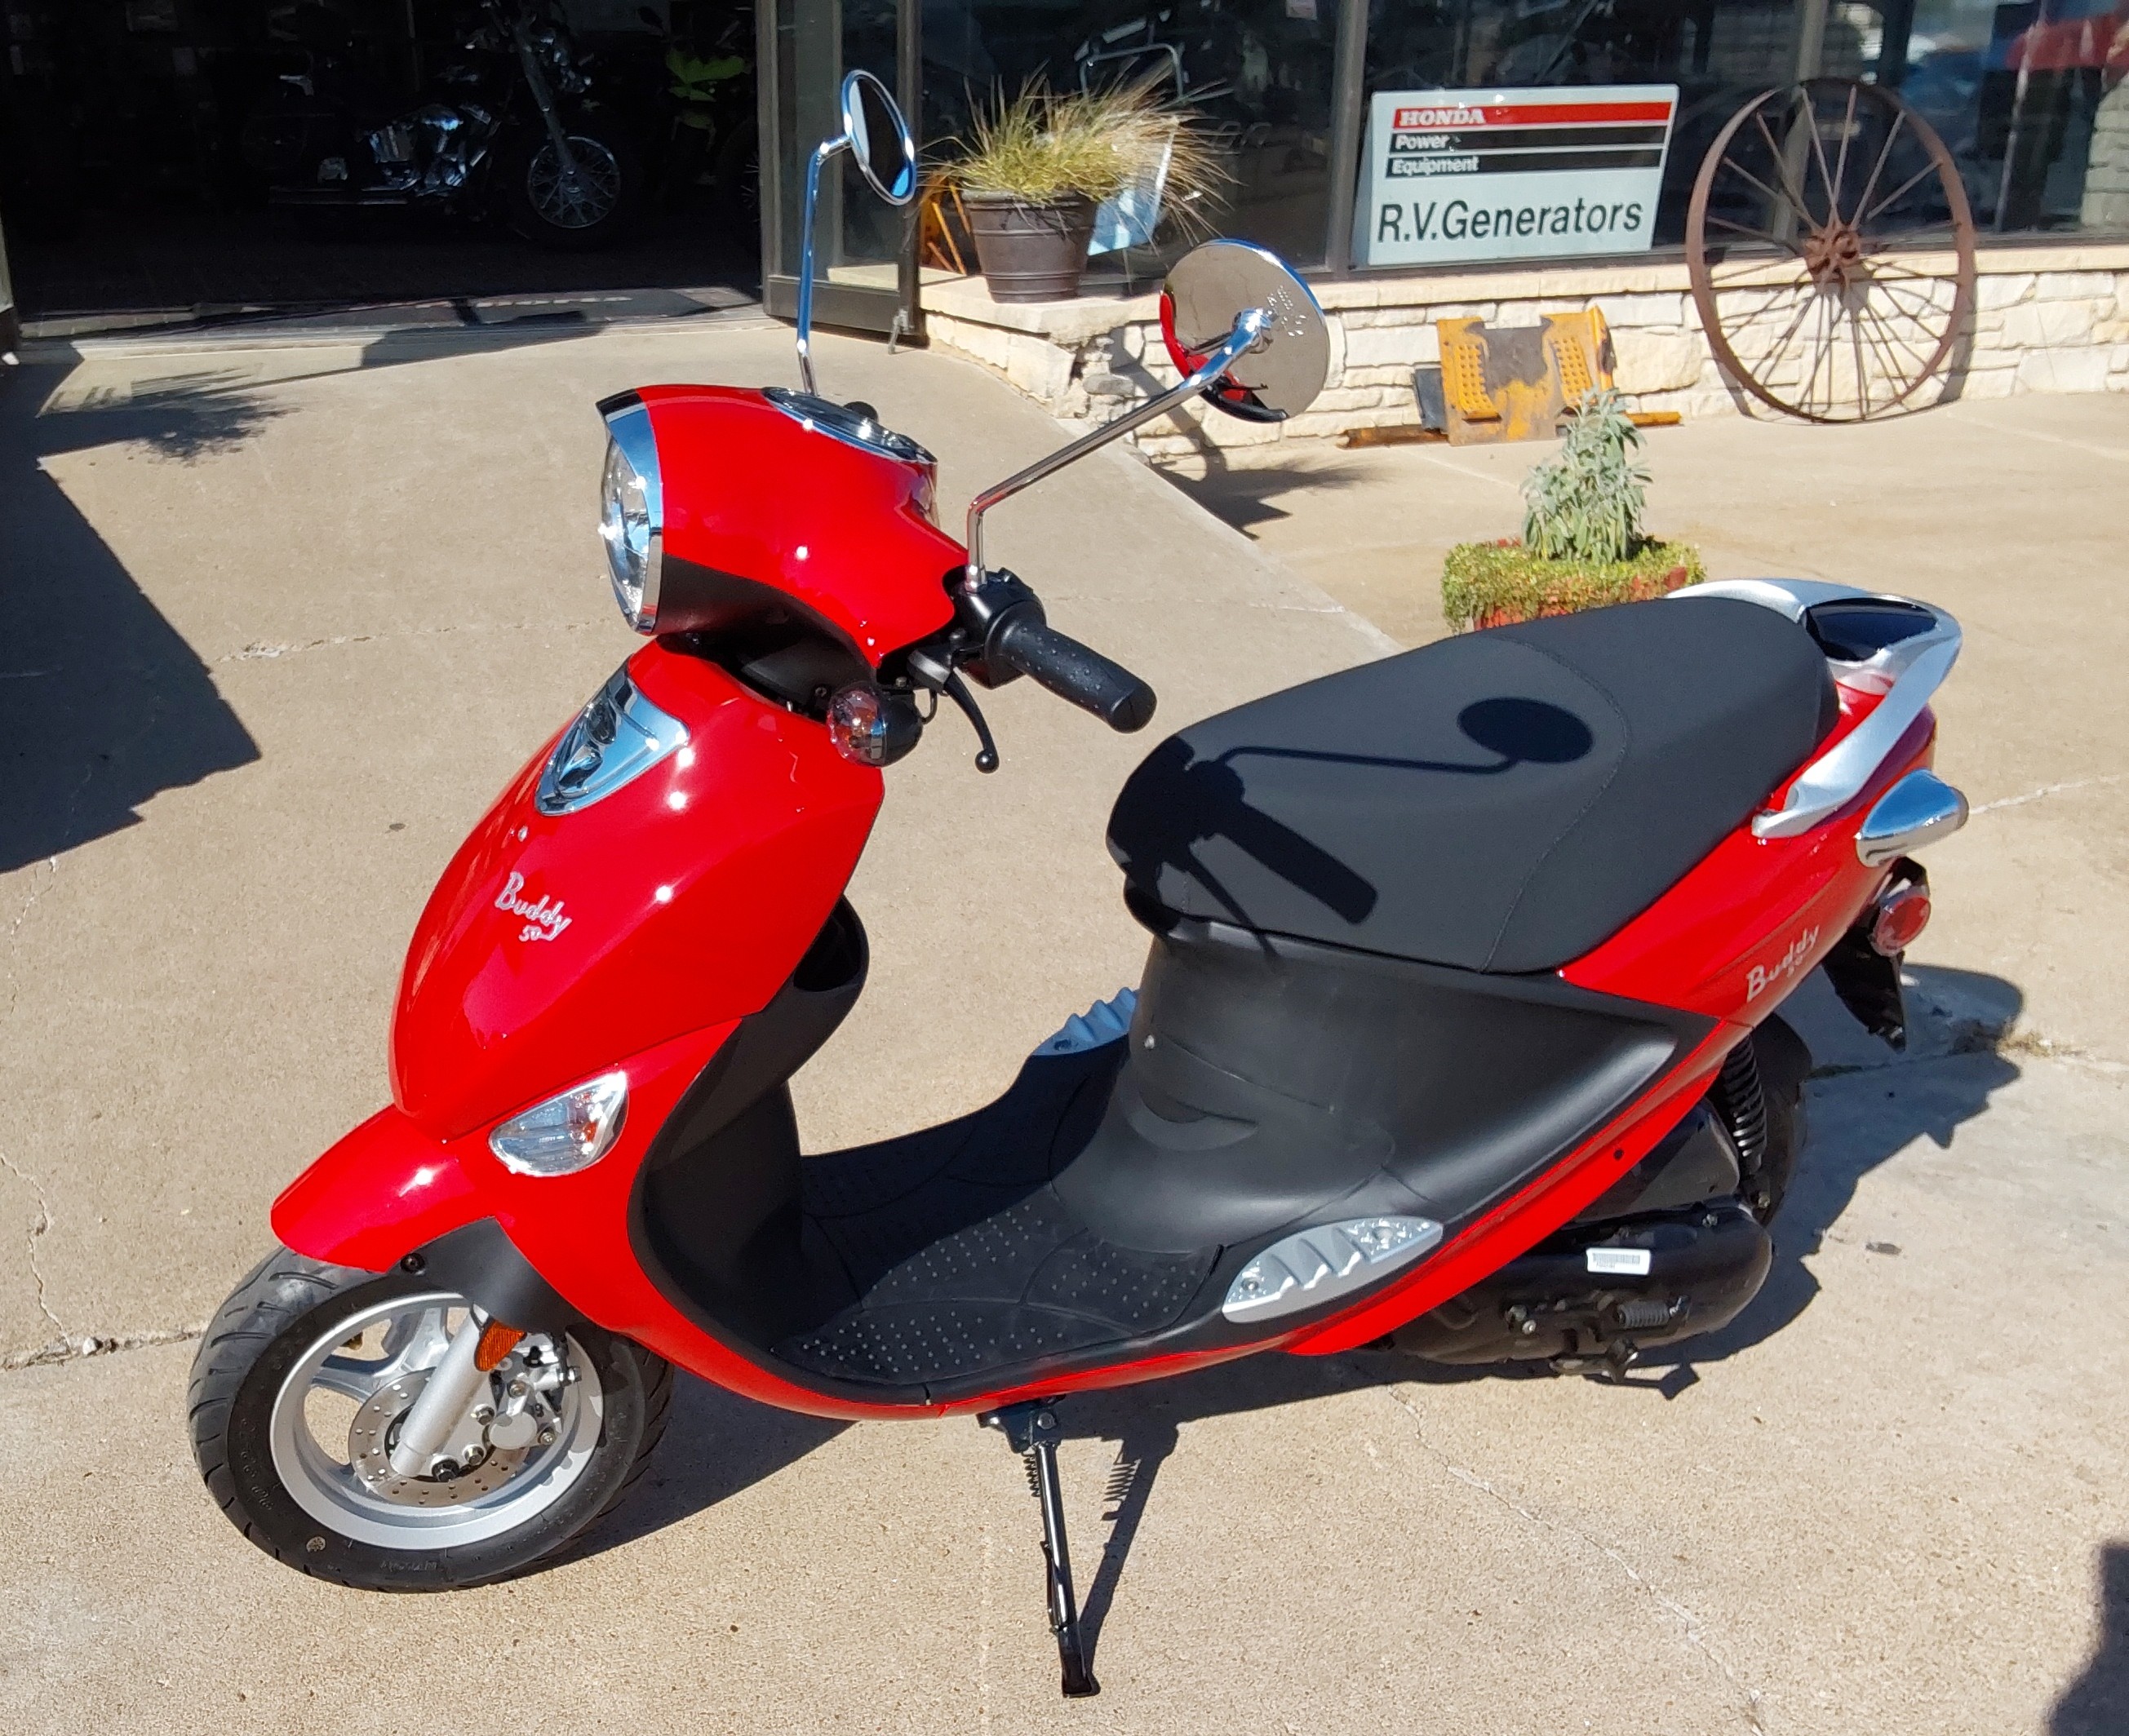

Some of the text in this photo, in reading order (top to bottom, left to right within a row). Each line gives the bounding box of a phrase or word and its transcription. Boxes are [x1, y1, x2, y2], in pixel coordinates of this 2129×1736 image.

[1399, 108, 1486, 126] HONDA
[1395, 133, 1450, 151] Power
[1391, 156, 1479, 176] Equipment
[495, 871, 573, 941] Buddy
[1745, 924, 1820, 1003] Buddy
